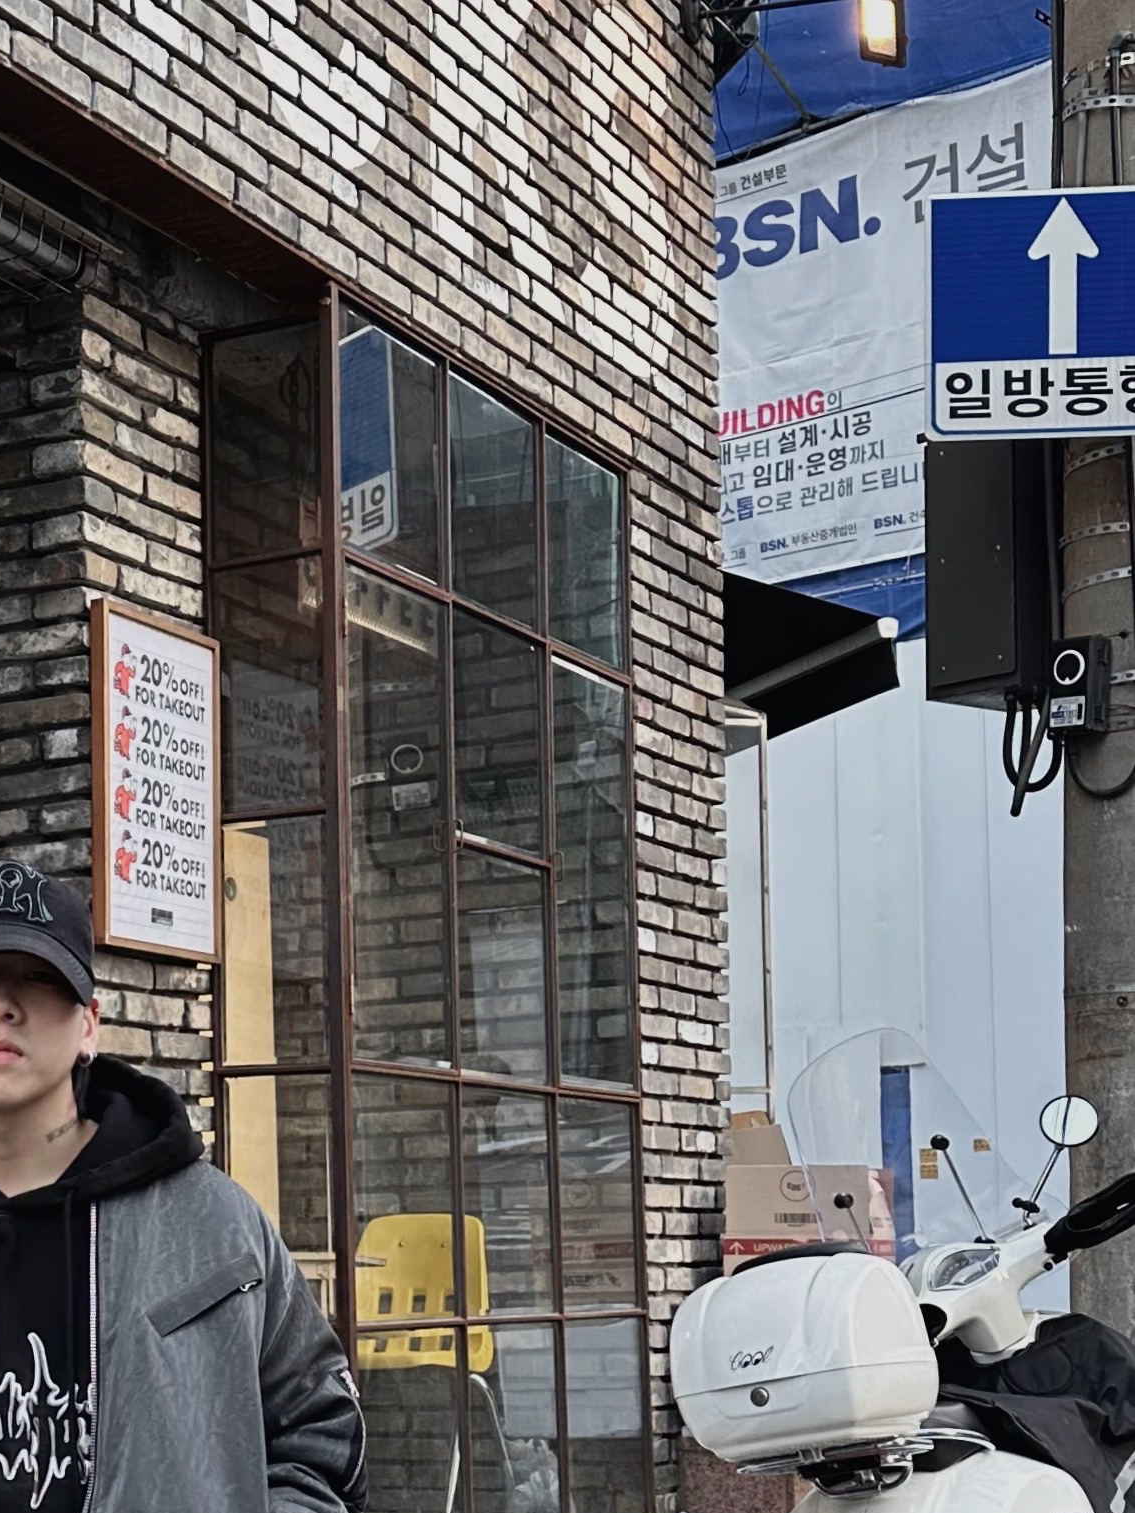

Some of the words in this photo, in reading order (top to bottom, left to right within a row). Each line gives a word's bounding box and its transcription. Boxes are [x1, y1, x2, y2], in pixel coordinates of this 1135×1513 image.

[740, 164, 787, 190] 건설부문
[778, 411, 872, 455] 설계·시공
[752, 439, 884, 488] 임대·운영까지
[800, 476, 853, 508] 관리해
[862, 461, 925, 493] 드립니
[141, 654, 178, 692] 20%
[180, 678, 204, 702] OFF!
[136, 685, 156, 708] FOR
[159, 692, 205, 724] TAKEOUT
[141, 716, 178, 752] 20%
[180, 738, 205, 760] OFF!
[136, 747, 156, 768] FOR
[160, 753, 205, 782] TAKEOUT
[141, 777, 179, 812] 20%
[181, 798, 206, 820] OFF!
[136, 808, 156, 829] FOR
[160, 814, 206, 841] TAKEOUT
[141, 838, 179, 873] 20%
[182, 858, 206, 879] OFF!
[136, 869, 157, 889] FOR
[160, 874, 206, 900] TAKEOUT
